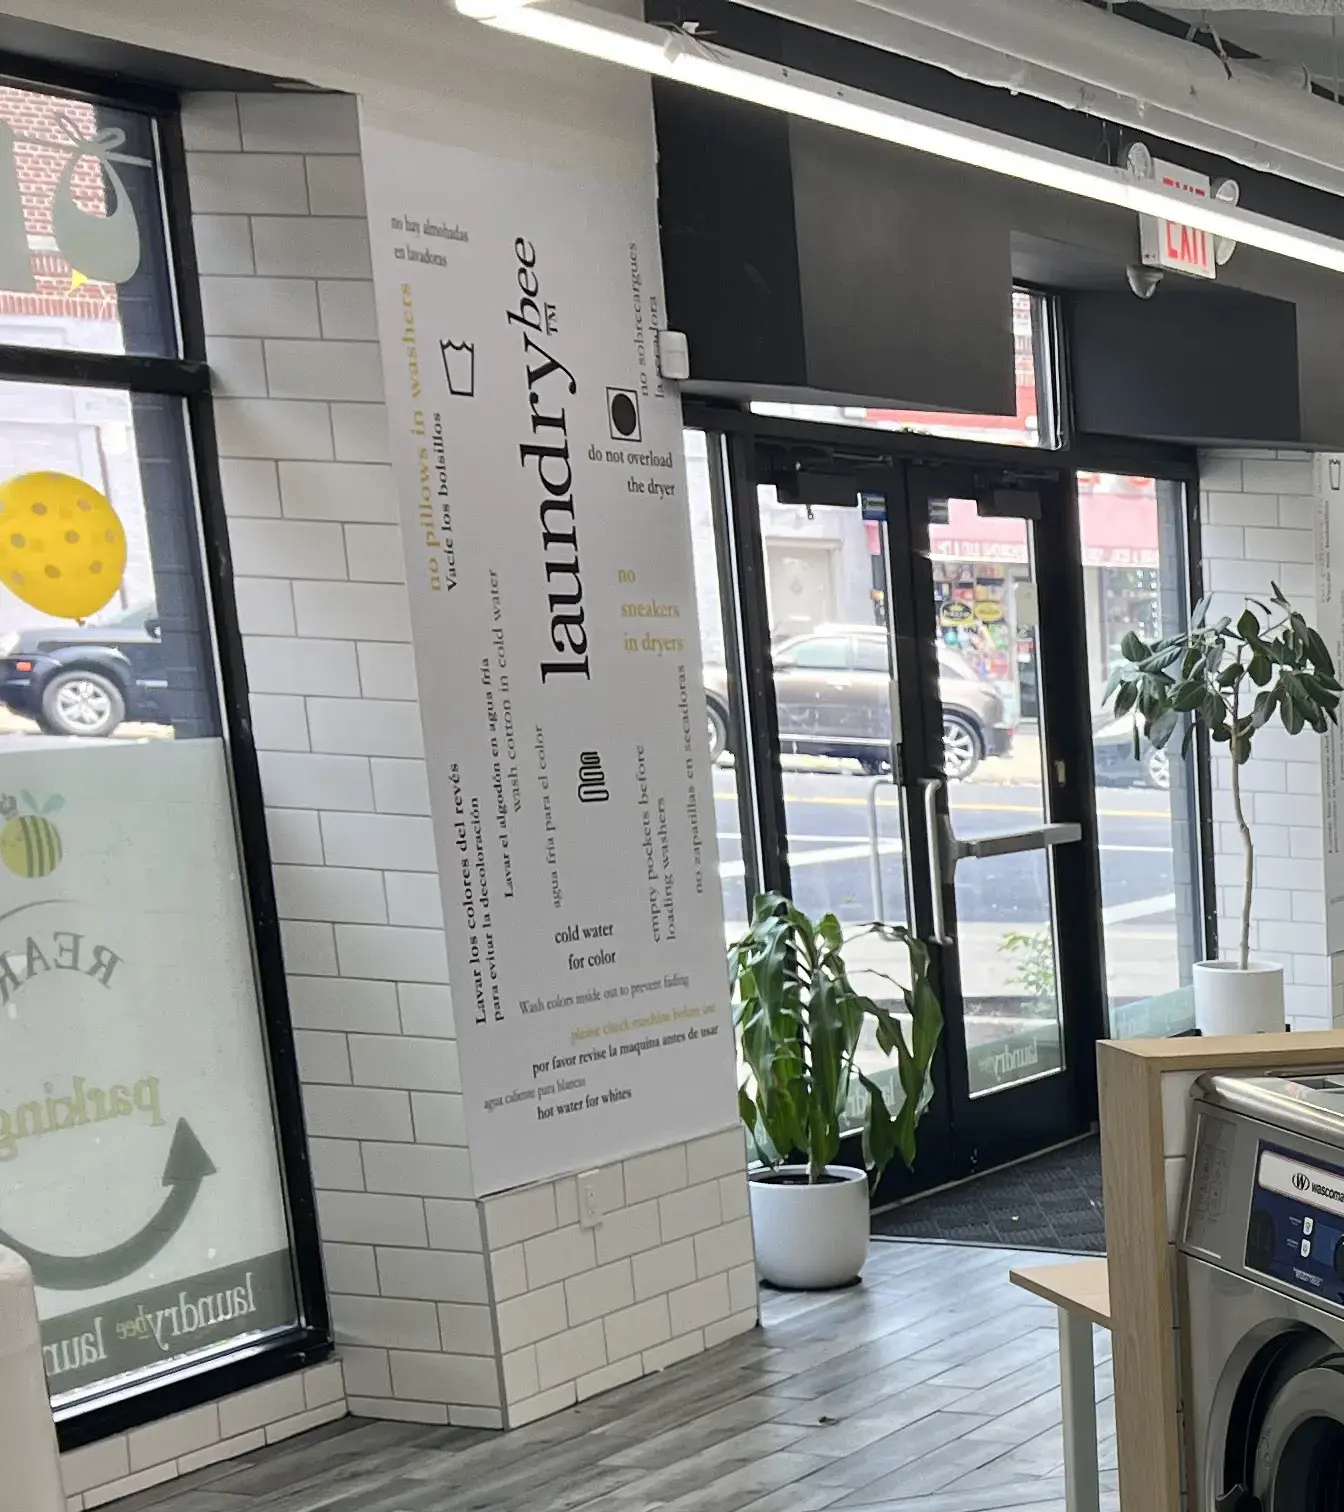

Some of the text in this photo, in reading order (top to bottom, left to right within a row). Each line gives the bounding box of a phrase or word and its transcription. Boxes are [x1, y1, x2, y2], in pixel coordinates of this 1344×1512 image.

[629, 242, 648, 397] no sobrecargues
[402, 283, 442, 591] no pillows in washers
[432, 412, 449, 496] bolsillos
[506, 237, 591, 684] laundrybee
[588, 444, 674, 468] do not overload
[627, 477, 675, 500] the dryer
[441, 504, 453, 531] los
[618, 569, 636, 583] no
[621, 599, 680, 617] sneakers
[624, 633, 684, 657] in dryers
[489, 569, 521, 813] wash cotton in cold water
[485, 692, 499, 732] agua
[491, 738, 499, 757] en
[534, 724, 547, 770] color
[538, 774, 549, 790] el
[677, 664, 704, 894] no zapatillas en secadoras
[542, 796, 556, 832] para
[498, 834, 508, 849] el
[635, 745, 661, 943] empty pockets before
[503, 853, 515, 898] Lavar
[657, 798, 676, 940] loading washers
[449, 763, 487, 1025] Lavar los colores del revés
[548, 871, 563, 908] agua
[482, 913, 492, 929] la
[555, 923, 614, 944] cold water
[485, 934, 498, 980] evitar
[568, 950, 617, 970] for color
[492, 985, 505, 1022] para
[518, 997, 545, 1014] Wash
[547, 991, 574, 1009] colors
[603, 985, 618, 999] out
[620, 984, 629, 996] to
[631, 981, 662, 1000] prevent
[532, 1025, 719, 1078] por favor revise la maquina antes de usar
[537, 1088, 632, 1120] hot water for whites
